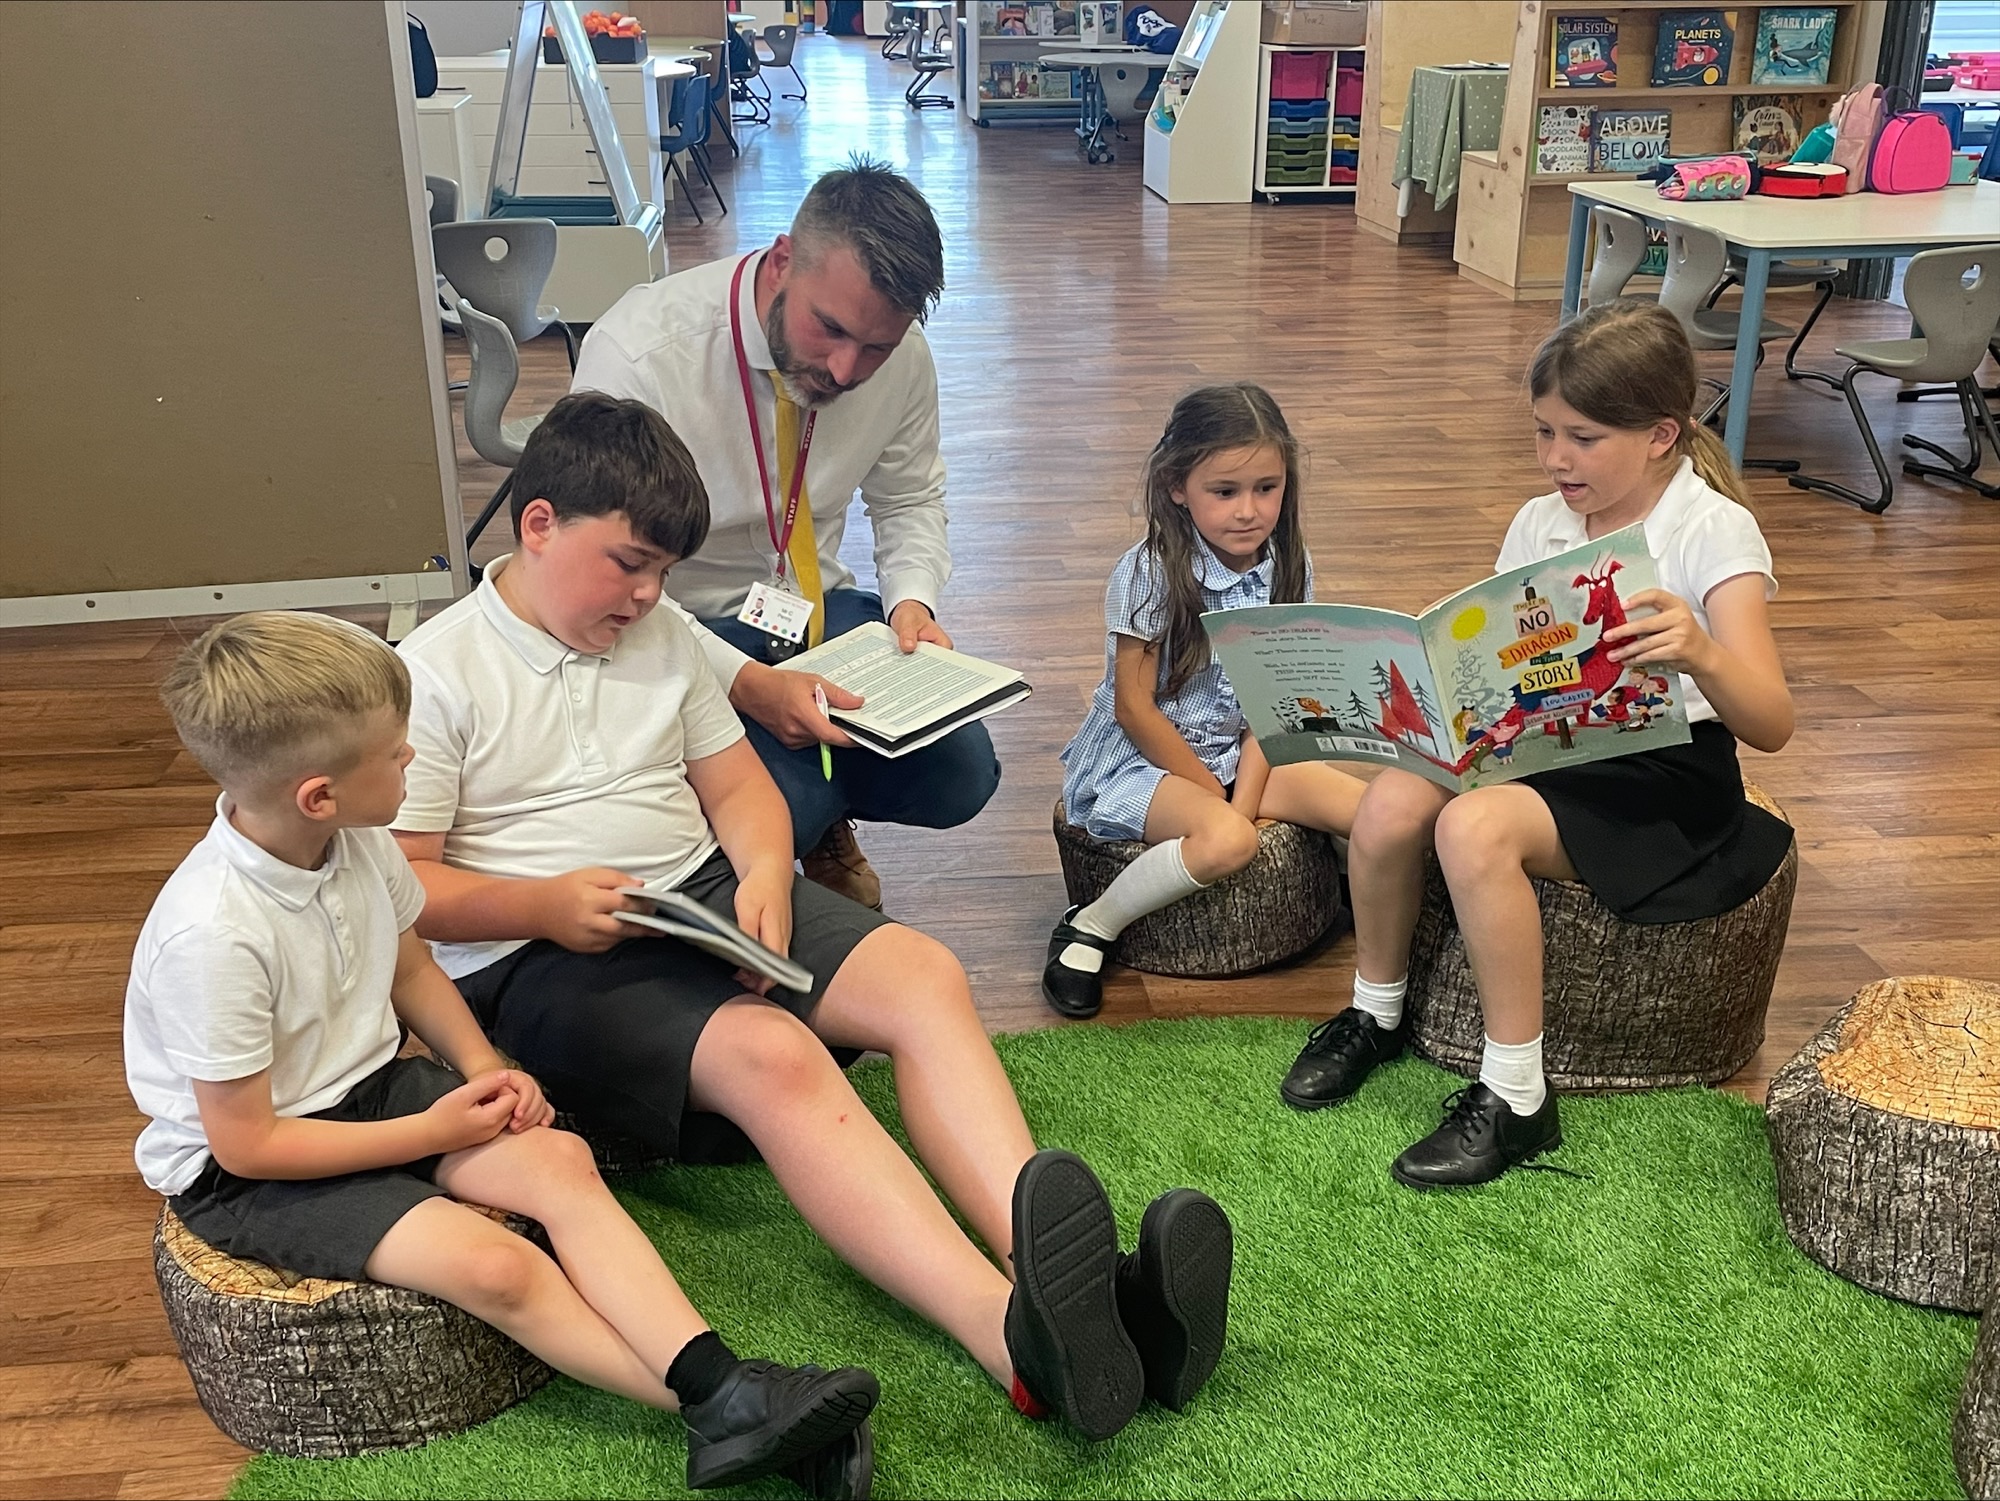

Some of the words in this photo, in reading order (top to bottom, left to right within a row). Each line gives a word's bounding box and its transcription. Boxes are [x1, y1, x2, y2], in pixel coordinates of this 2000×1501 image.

[1318, 14, 1325, 26] 2
[1558, 22, 1583, 34] SOLAR
[1585, 22, 1616, 34] SYSTEM
[1771, 17, 1800, 30] SHARK
[1803, 17, 1829, 30] LADY
[1675, 29, 1721, 40] PLANETS
[1600, 115, 1670, 137] ABOVE
[1600, 141, 1666, 161] BELOW
[804, 422, 813, 449] STAFF
[787, 498, 796, 525] STAFF
[1516, 600, 1536, 610] THERE
[1519, 610, 1550, 633] NO
[1509, 626, 1572, 662] DRAGON
[1524, 662, 1574, 690] STORY
[1562, 691, 1592, 702] CARTER
